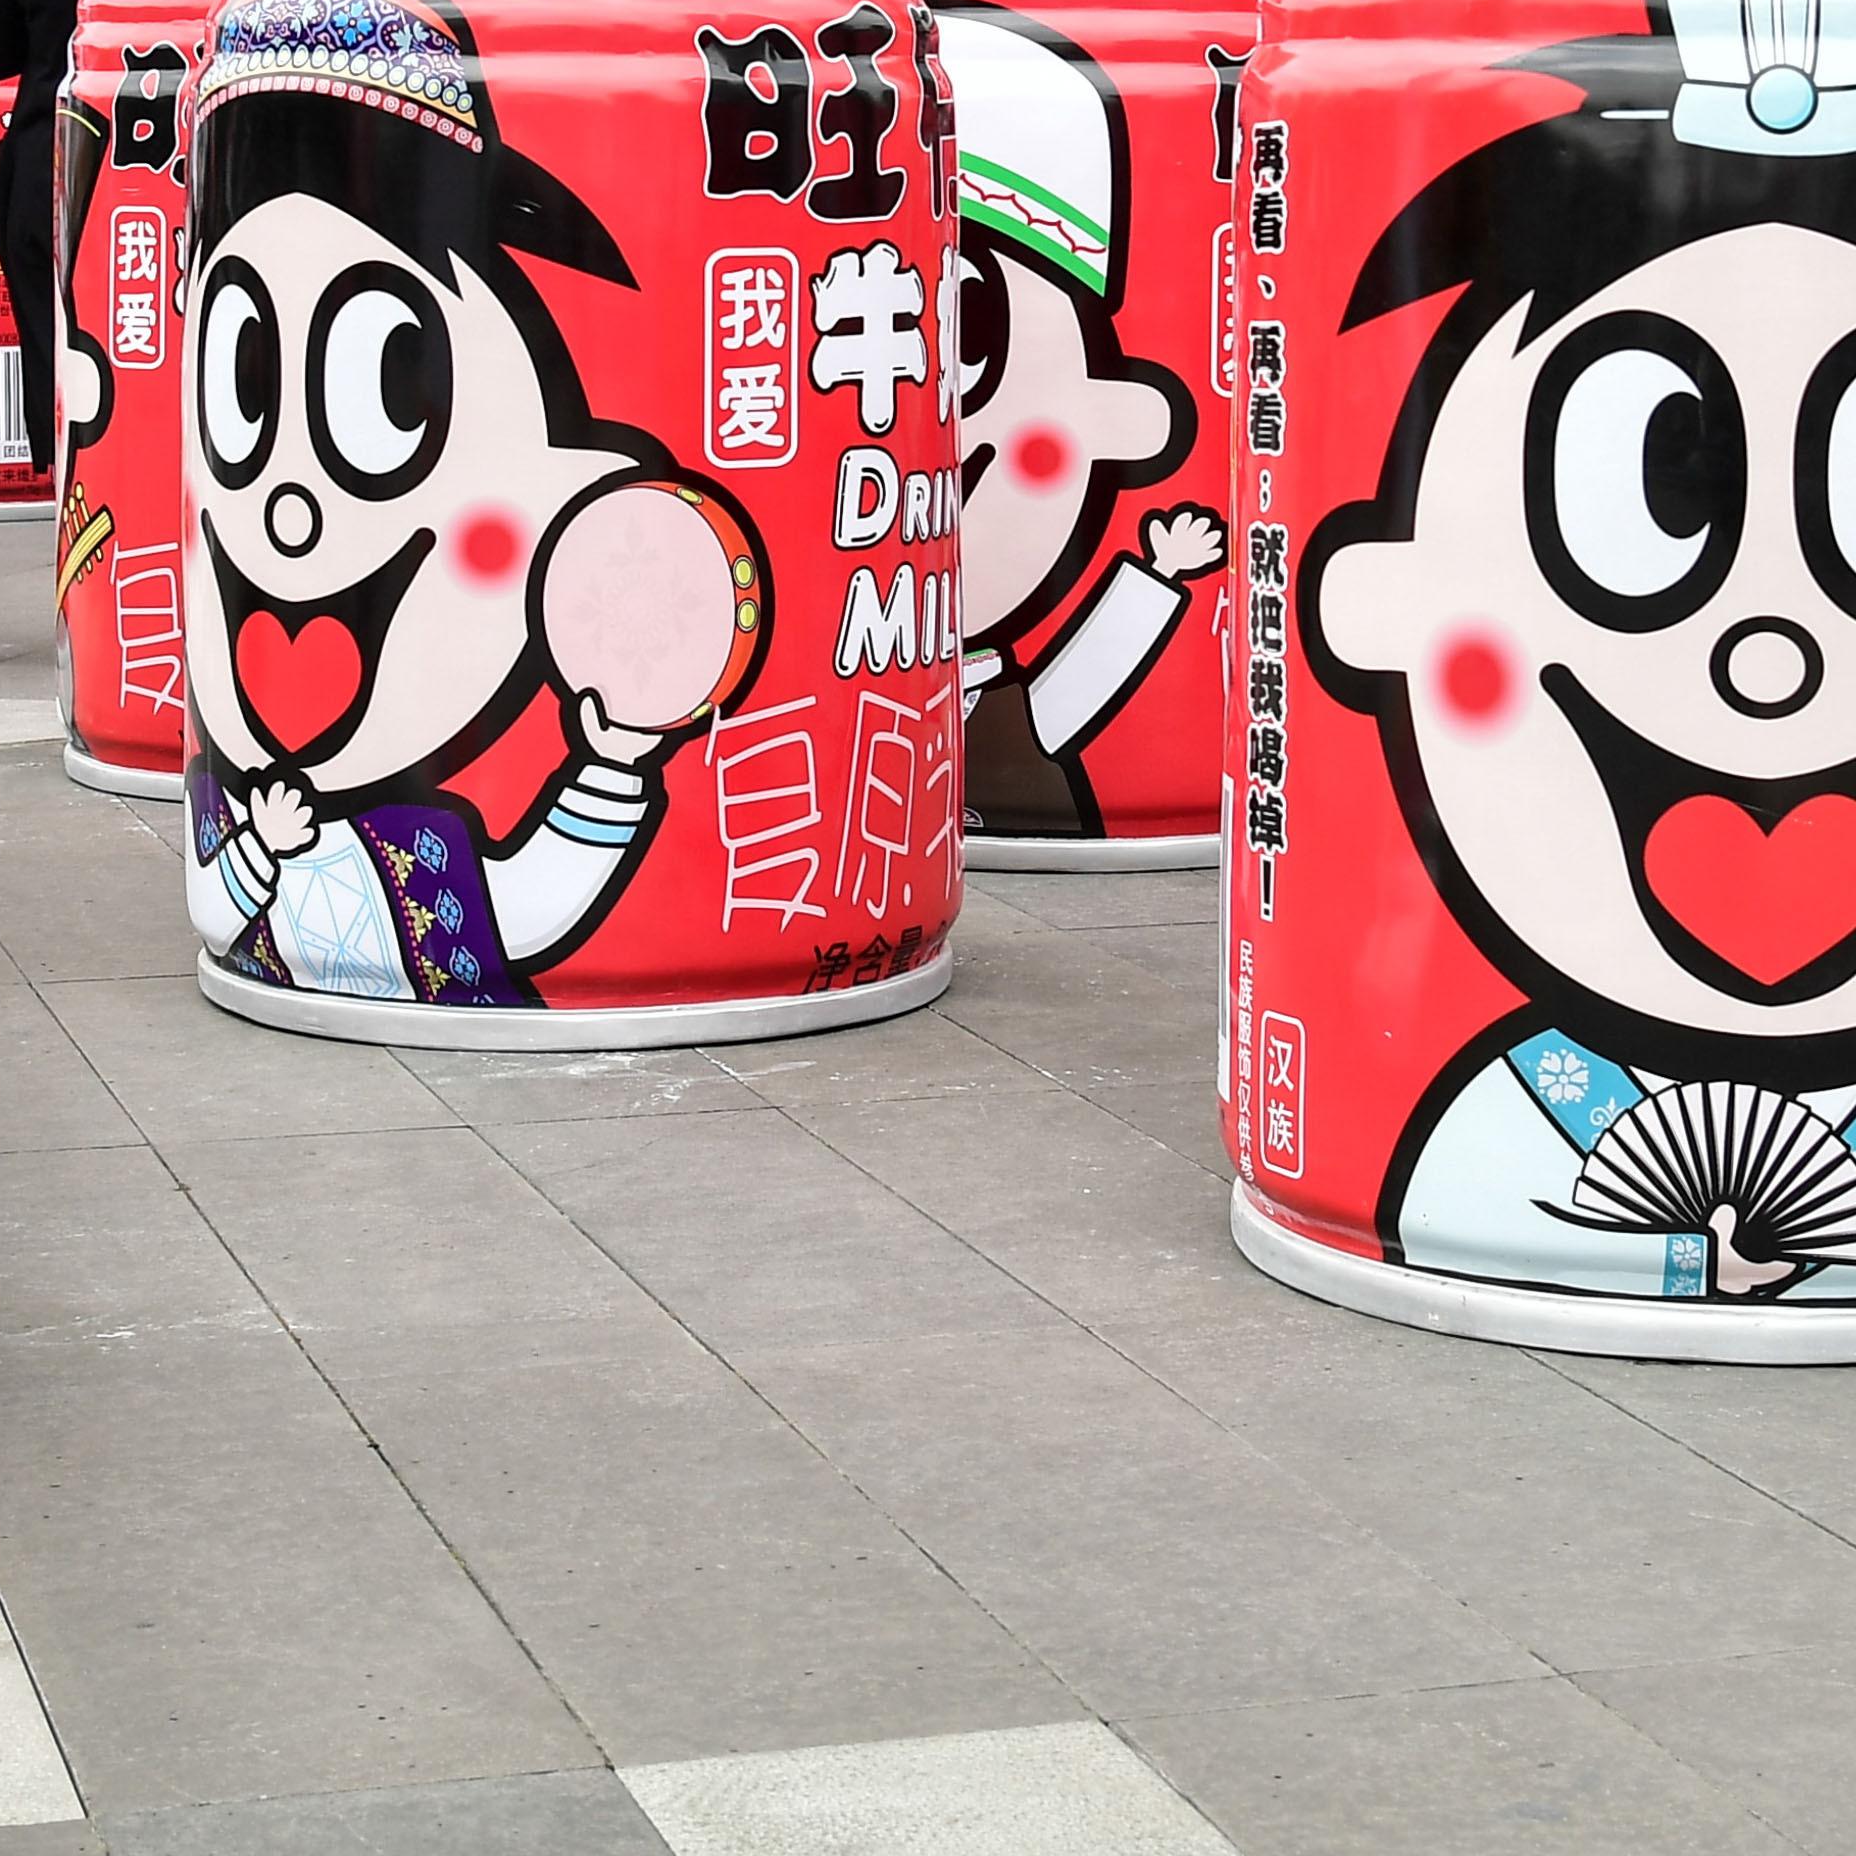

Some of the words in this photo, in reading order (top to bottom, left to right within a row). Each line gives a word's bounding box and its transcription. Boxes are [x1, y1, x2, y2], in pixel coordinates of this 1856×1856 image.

[116, 220, 161, 358] 我爱
[718, 266, 788, 448] 我爱
[1267, 1034, 1295, 1155] 汉族
